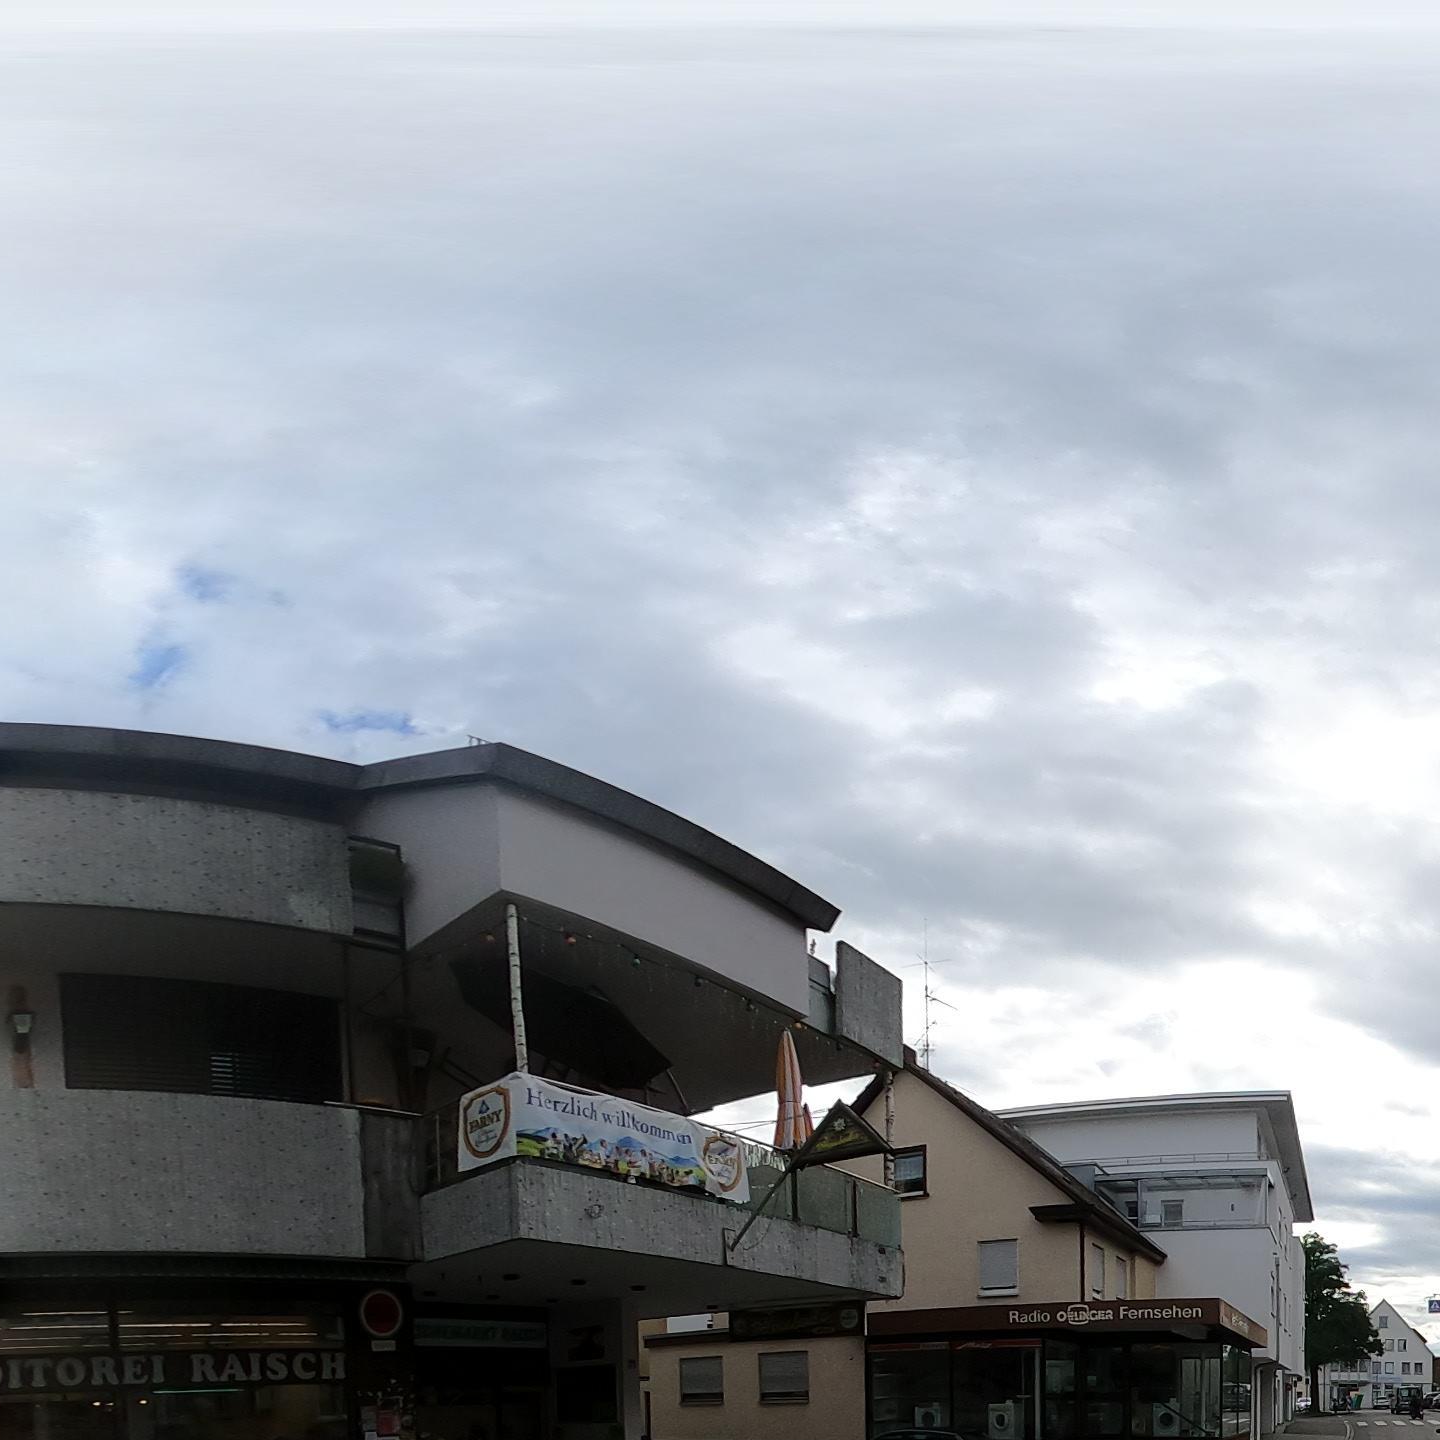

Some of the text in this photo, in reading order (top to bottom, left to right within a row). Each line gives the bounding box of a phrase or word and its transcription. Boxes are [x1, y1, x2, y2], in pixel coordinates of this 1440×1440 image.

[526, 1088, 598, 1122] Herzlich
[1009, 1310, 1050, 1323] Radio
[1119, 1306, 1202, 1320] Fernsehen
[189, 1352, 347, 1384] RAISCH
